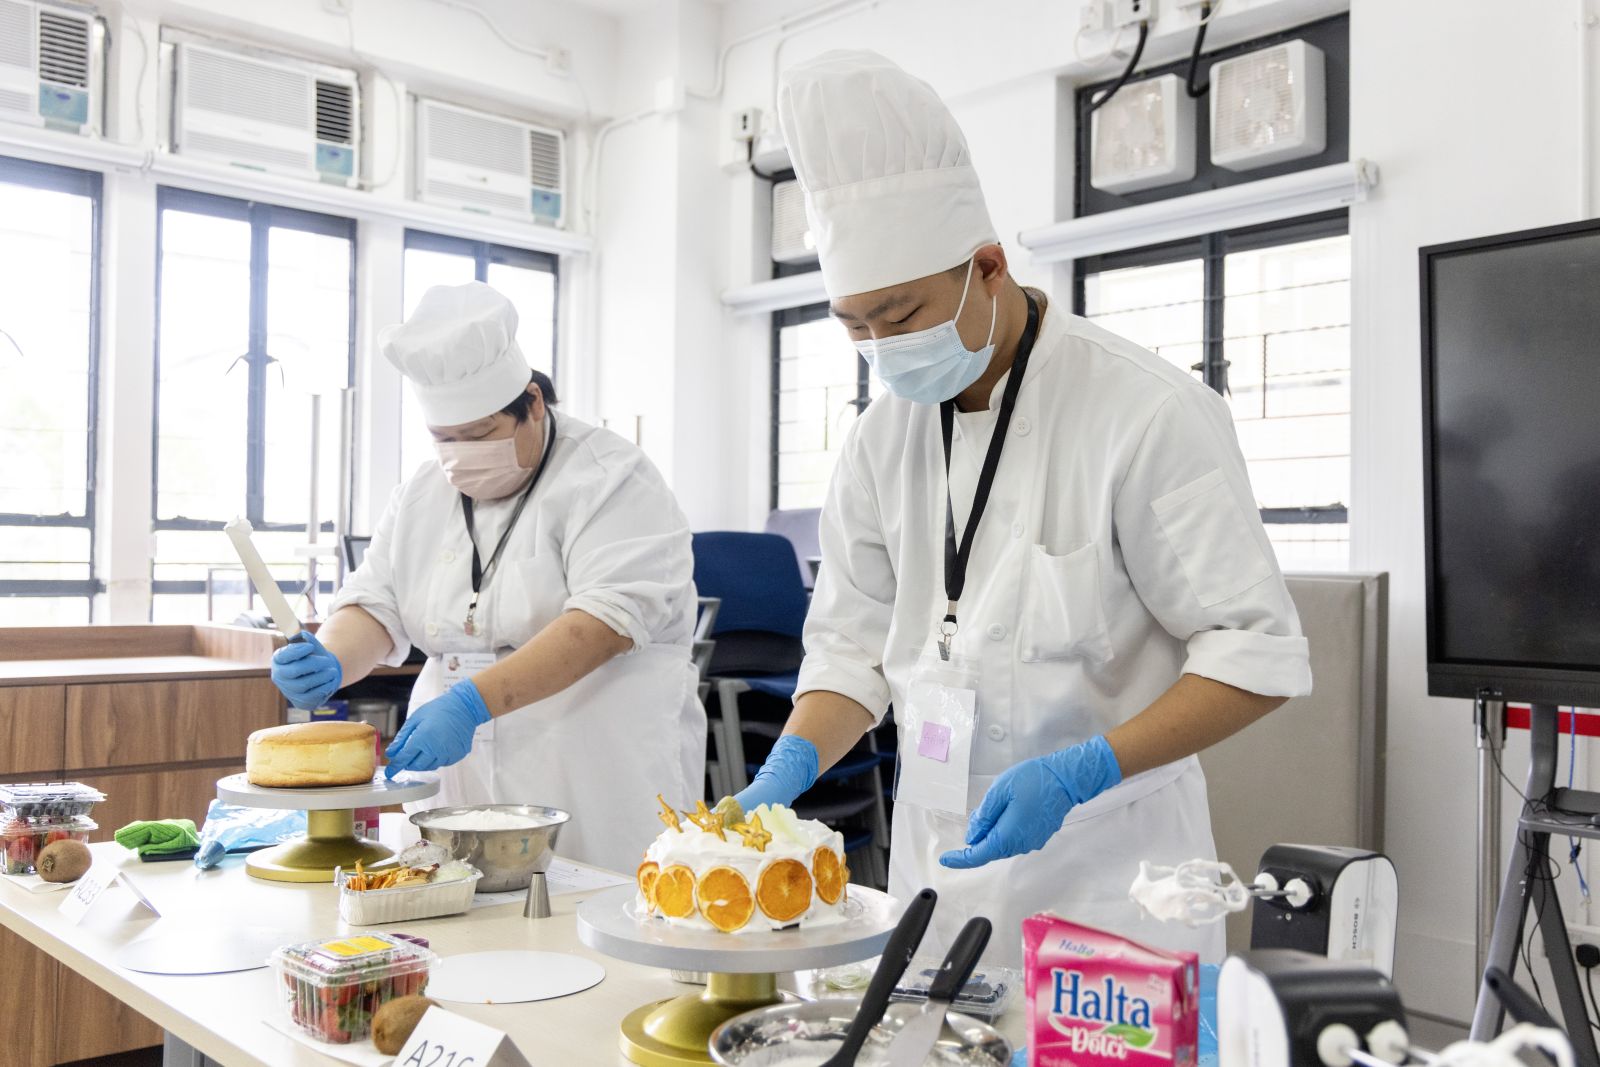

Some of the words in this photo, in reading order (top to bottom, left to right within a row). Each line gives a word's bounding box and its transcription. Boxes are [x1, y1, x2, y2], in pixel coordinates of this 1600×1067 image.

[1059, 939, 1095, 956] Halta
[1052, 970, 1151, 1029] Halta
[1071, 1027, 1127, 1059] Dolci
